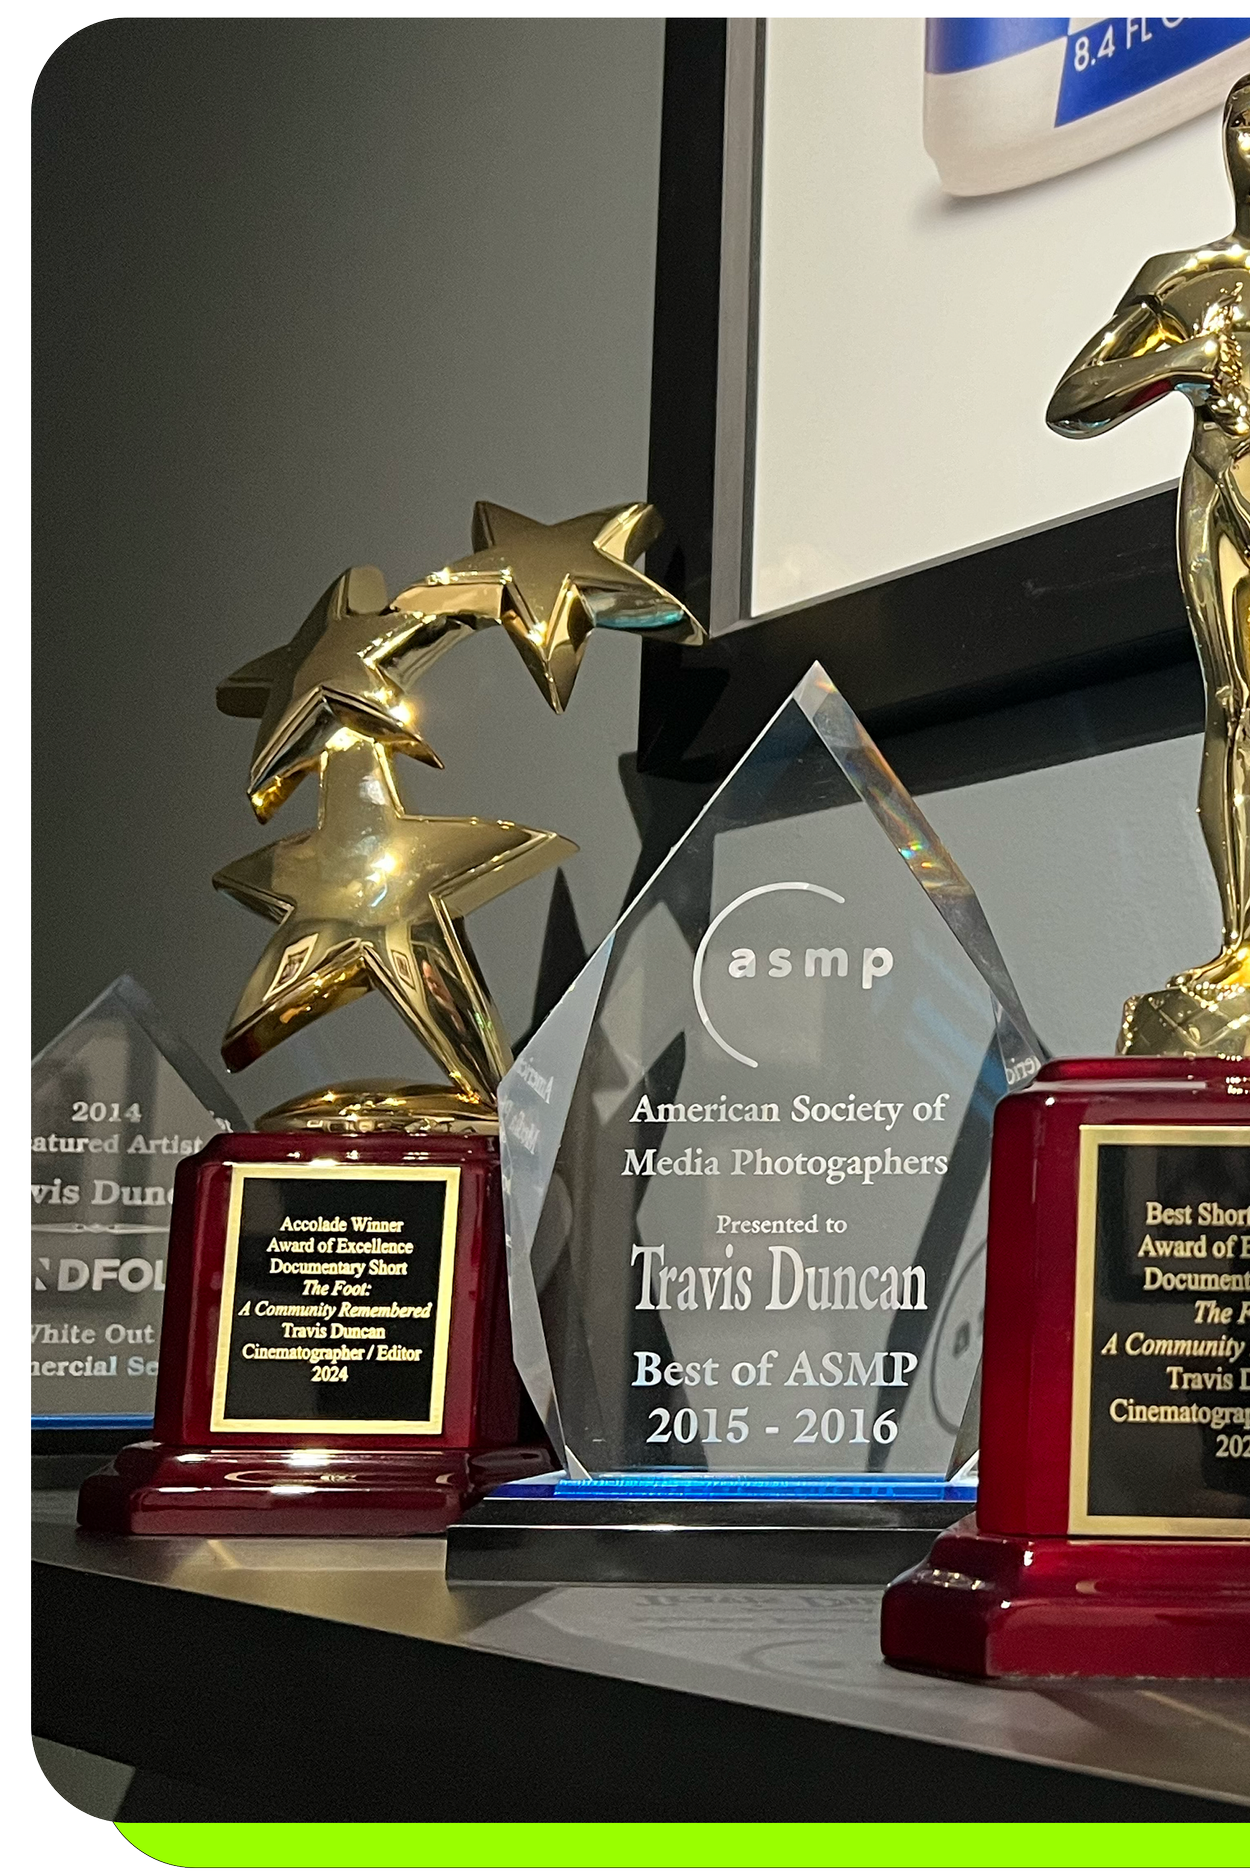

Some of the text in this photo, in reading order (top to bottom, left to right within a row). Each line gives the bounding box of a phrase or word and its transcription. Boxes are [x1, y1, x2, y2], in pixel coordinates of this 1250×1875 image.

[1074, 17, 1153, 72] 8.4 FL
[728, 947, 894, 990] asmp
[71, 1101, 142, 1123] 2014
[629, 1093, 950, 1131] American Society of
[31, 1134, 203, 1155] atured Artist
[621, 1147, 948, 1185] Media Photogaphers
[280, 1216, 404, 1233] Accolade Winner
[715, 1214, 848, 1235] Presented to
[1146, 1201, 1193, 1226] Best
[266, 1237, 414, 1254] Award of Excellence
[1137, 1234, 1207, 1259] Award
[1212, 1235, 1238, 1259] of
[270, 1258, 408, 1278] Documentary Short
[630, 1243, 928, 1312] Travis Duncan
[302, 1280, 372, 1296] The Foot:
[238, 1301, 433, 1320] A Community Remembered
[1194, 1301, 1232, 1324] The
[105, 1323, 155, 1344] Out
[282, 1322, 386, 1339] Travis Duncan
[242, 1343, 366, 1364] Cinematographer
[376, 1345, 422, 1362] Editor
[1101, 1333, 1118, 1356] A
[1125, 1333, 1245, 1362] Community
[311, 1366, 349, 1382] 2024
[631, 1350, 919, 1387] Best of ASMP
[1166, 1367, 1233, 1391] Travis
[646, 1407, 749, 1444] 2015
[794, 1407, 898, 1445] 2016
